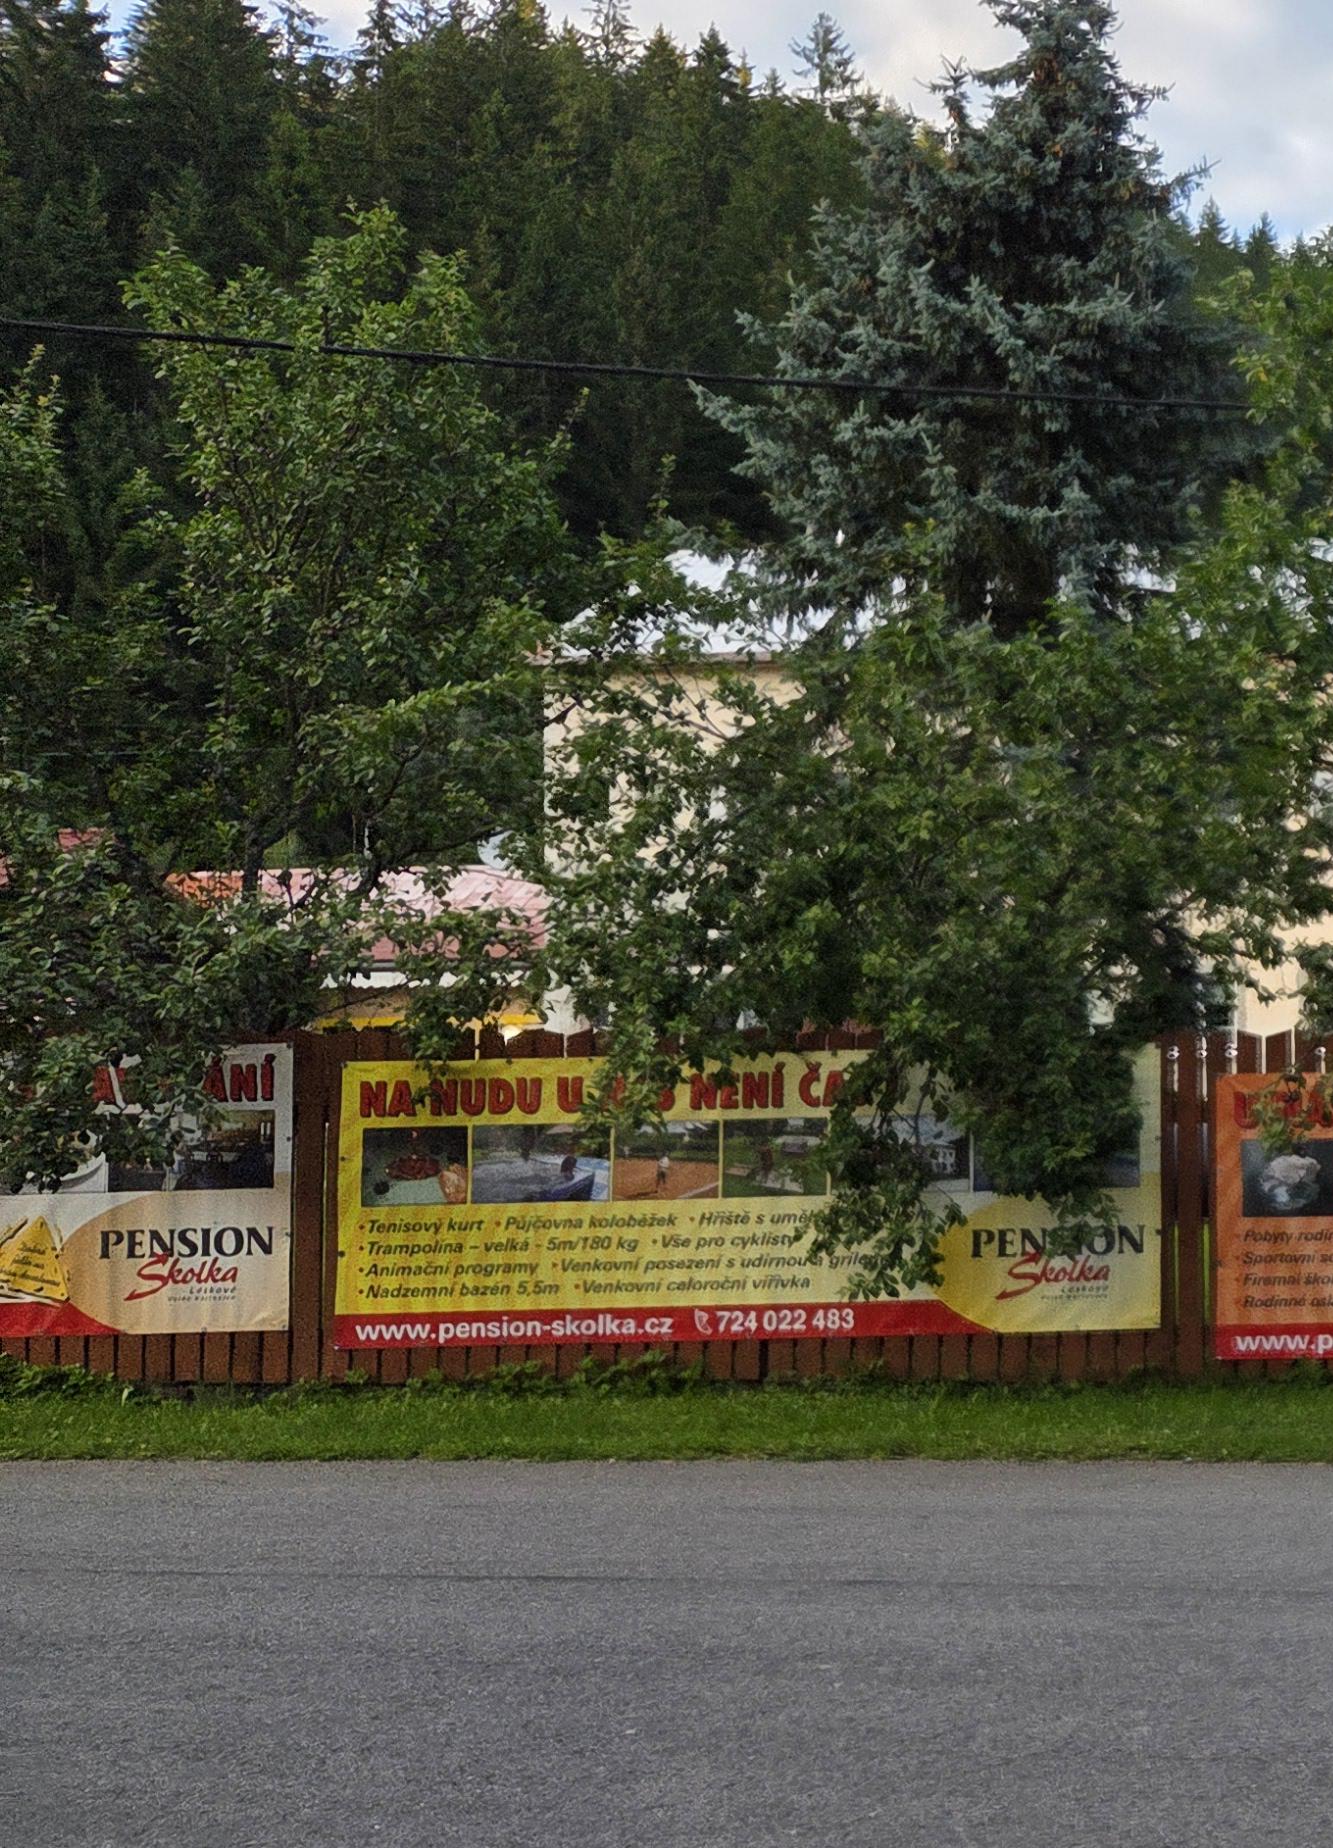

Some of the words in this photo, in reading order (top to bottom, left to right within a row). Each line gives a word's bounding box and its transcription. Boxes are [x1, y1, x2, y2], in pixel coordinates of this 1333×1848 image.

[360, 1079, 417, 1117] NA
[429, 1076, 543, 1117] NUDU
[556, 1076, 585, 1113] U
[689, 1061, 786, 1111] NENÍ
[798, 1061, 862, 1108] ČA
[368, 1217, 442, 1235] Tenisový
[447, 1217, 484, 1232] kurt
[504, 1215, 584, 1234] Půjčovna
[588, 1212, 677, 1229] koloběžek
[698, 1208, 750, 1226] Hřiště
[755, 1213, 766, 1225] s
[100, 1227, 273, 1259] PENSION
[484, 1239, 529, 1252] velká
[546, 1235, 610, 1252] 5m/180
[616, 1235, 640, 1252] kg
[661, 1232, 691, 1249] Vše
[696, 1236, 726, 1253] pro
[730, 1231, 796, 1252] cyklisty
[971, 1224, 1147, 1259] PENON
[1243, 1230, 1293, 1245] Pobyty
[365, 1263, 450, 1277] Animační
[454, 1260, 540, 1279] programy
[560, 1255, 640, 1274] Venkovní
[643, 1255, 721, 1275] posezení
[725, 1257, 736, 1269] s
[365, 1283, 454, 1299] Nadzemní
[459, 1280, 511, 1297] bazén
[516, 1279, 561, 1298] 5,5m
[582, 1277, 661, 1295] Venkovní
[752, 1273, 811, 1290] vířivka
[355, 1313, 675, 1345] www.pension-skolka.cz
[716, 1309, 757, 1333] 724
[762, 1308, 807, 1331] 022
[811, 1307, 856, 1330] 483
